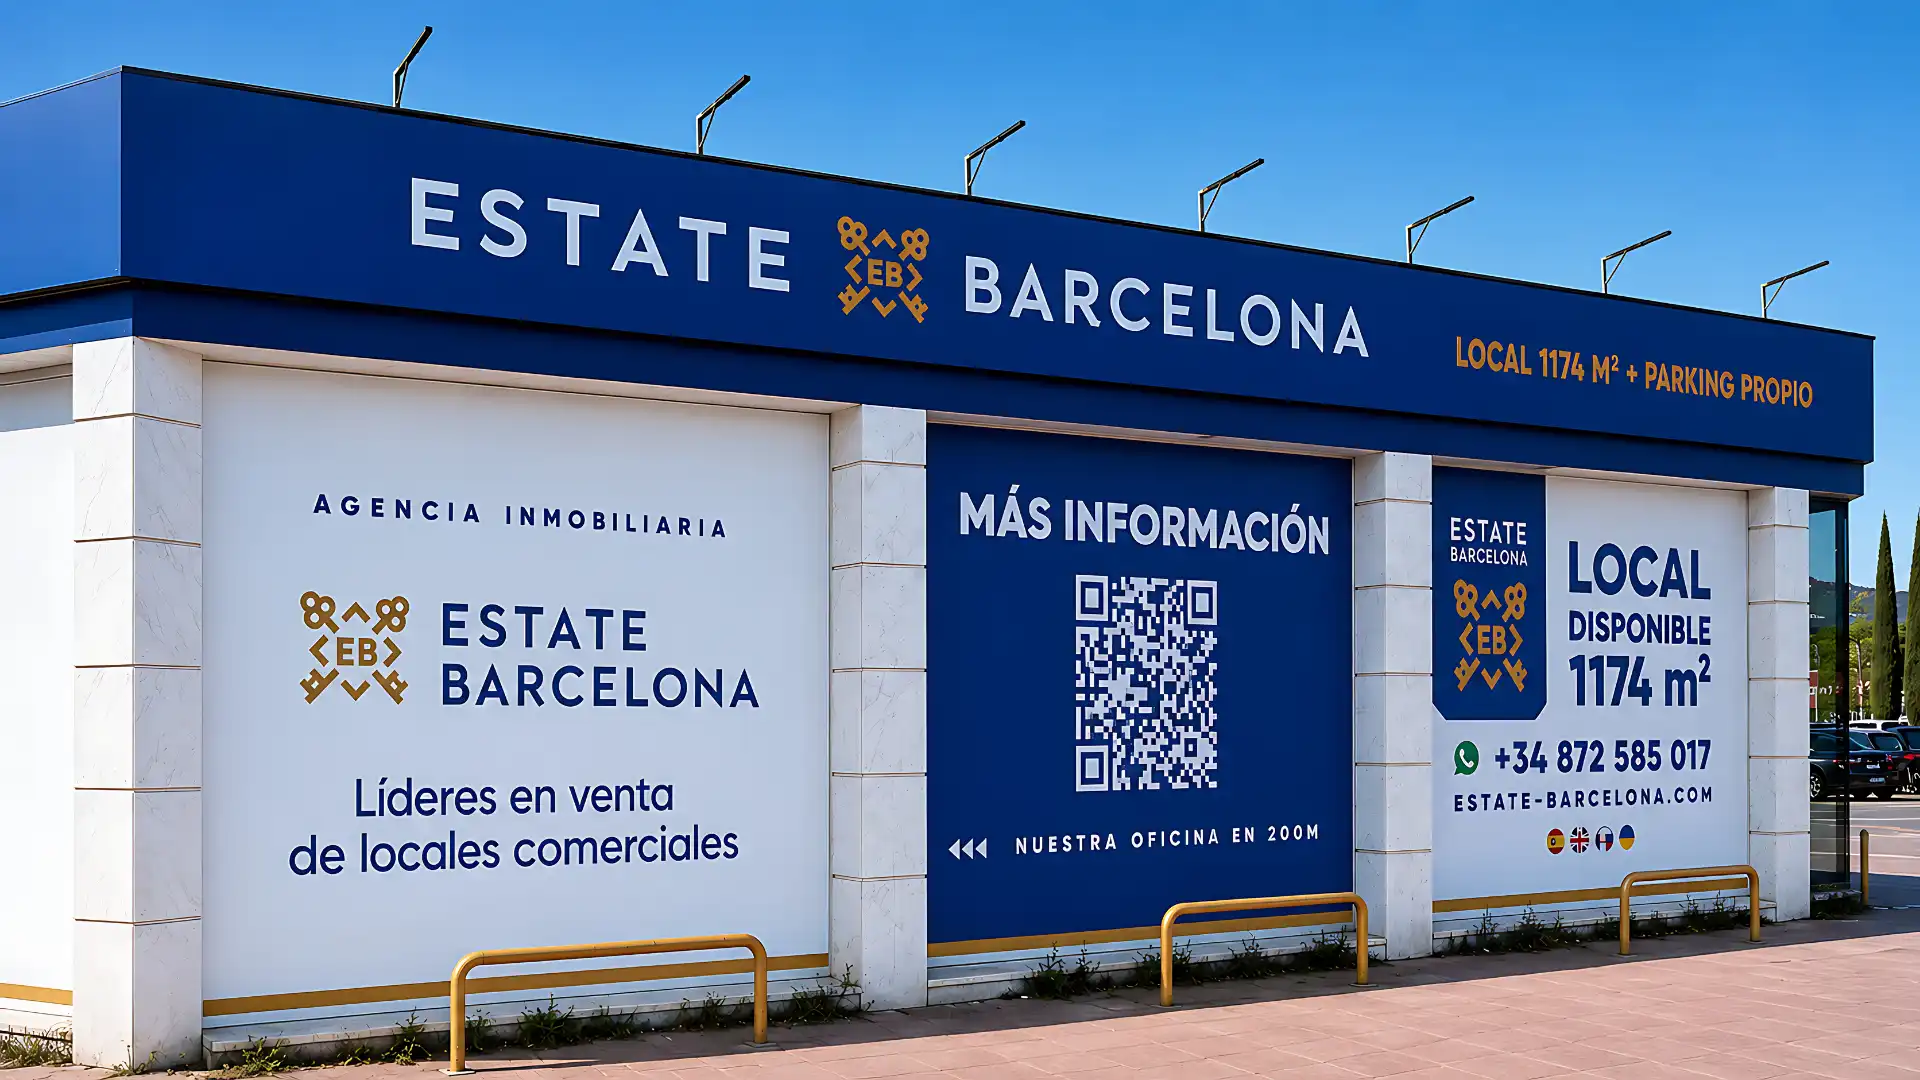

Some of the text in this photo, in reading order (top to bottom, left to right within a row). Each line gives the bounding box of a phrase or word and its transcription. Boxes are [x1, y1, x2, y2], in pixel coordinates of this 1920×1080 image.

[412, 178, 1370, 357] ESTATE BARCELONA
[867, 258, 903, 288] EB
[1457, 336, 1532, 375] LOCAL
[1539, 348, 1584, 381] 1174
[1626, 365, 1638, 382] +
[1646, 361, 1734, 399] PARKING
[1741, 374, 1813, 408] PROPIO
[313, 494, 725, 537] AGENCIA INMOBILIARIA
[960, 484, 1328, 554] MÁS INFORMACIÓN
[1451, 517, 1526, 545] ESTATE
[1450, 546, 1528, 567] BARCELONA
[1569, 541, 1711, 600] LOCAL
[443, 603, 646, 651] ESTATE
[1478, 625, 1506, 654] EB
[1569, 610, 1711, 645] DISPONIBLE
[337, 637, 377, 666] EB
[443, 663, 759, 708] BARCELONA
[1569, 655, 1652, 706] 1174
[1495, 740, 1710, 774] +34 872 585 017
[356, 777, 672, 816] Líderes en venta
[1455, 787, 1711, 812] ESTATE-BARCELONA.COM
[289, 824, 738, 875] de locales comerciales
[1016, 824, 1317, 854] NUESTRA OFICINA EN 200M
